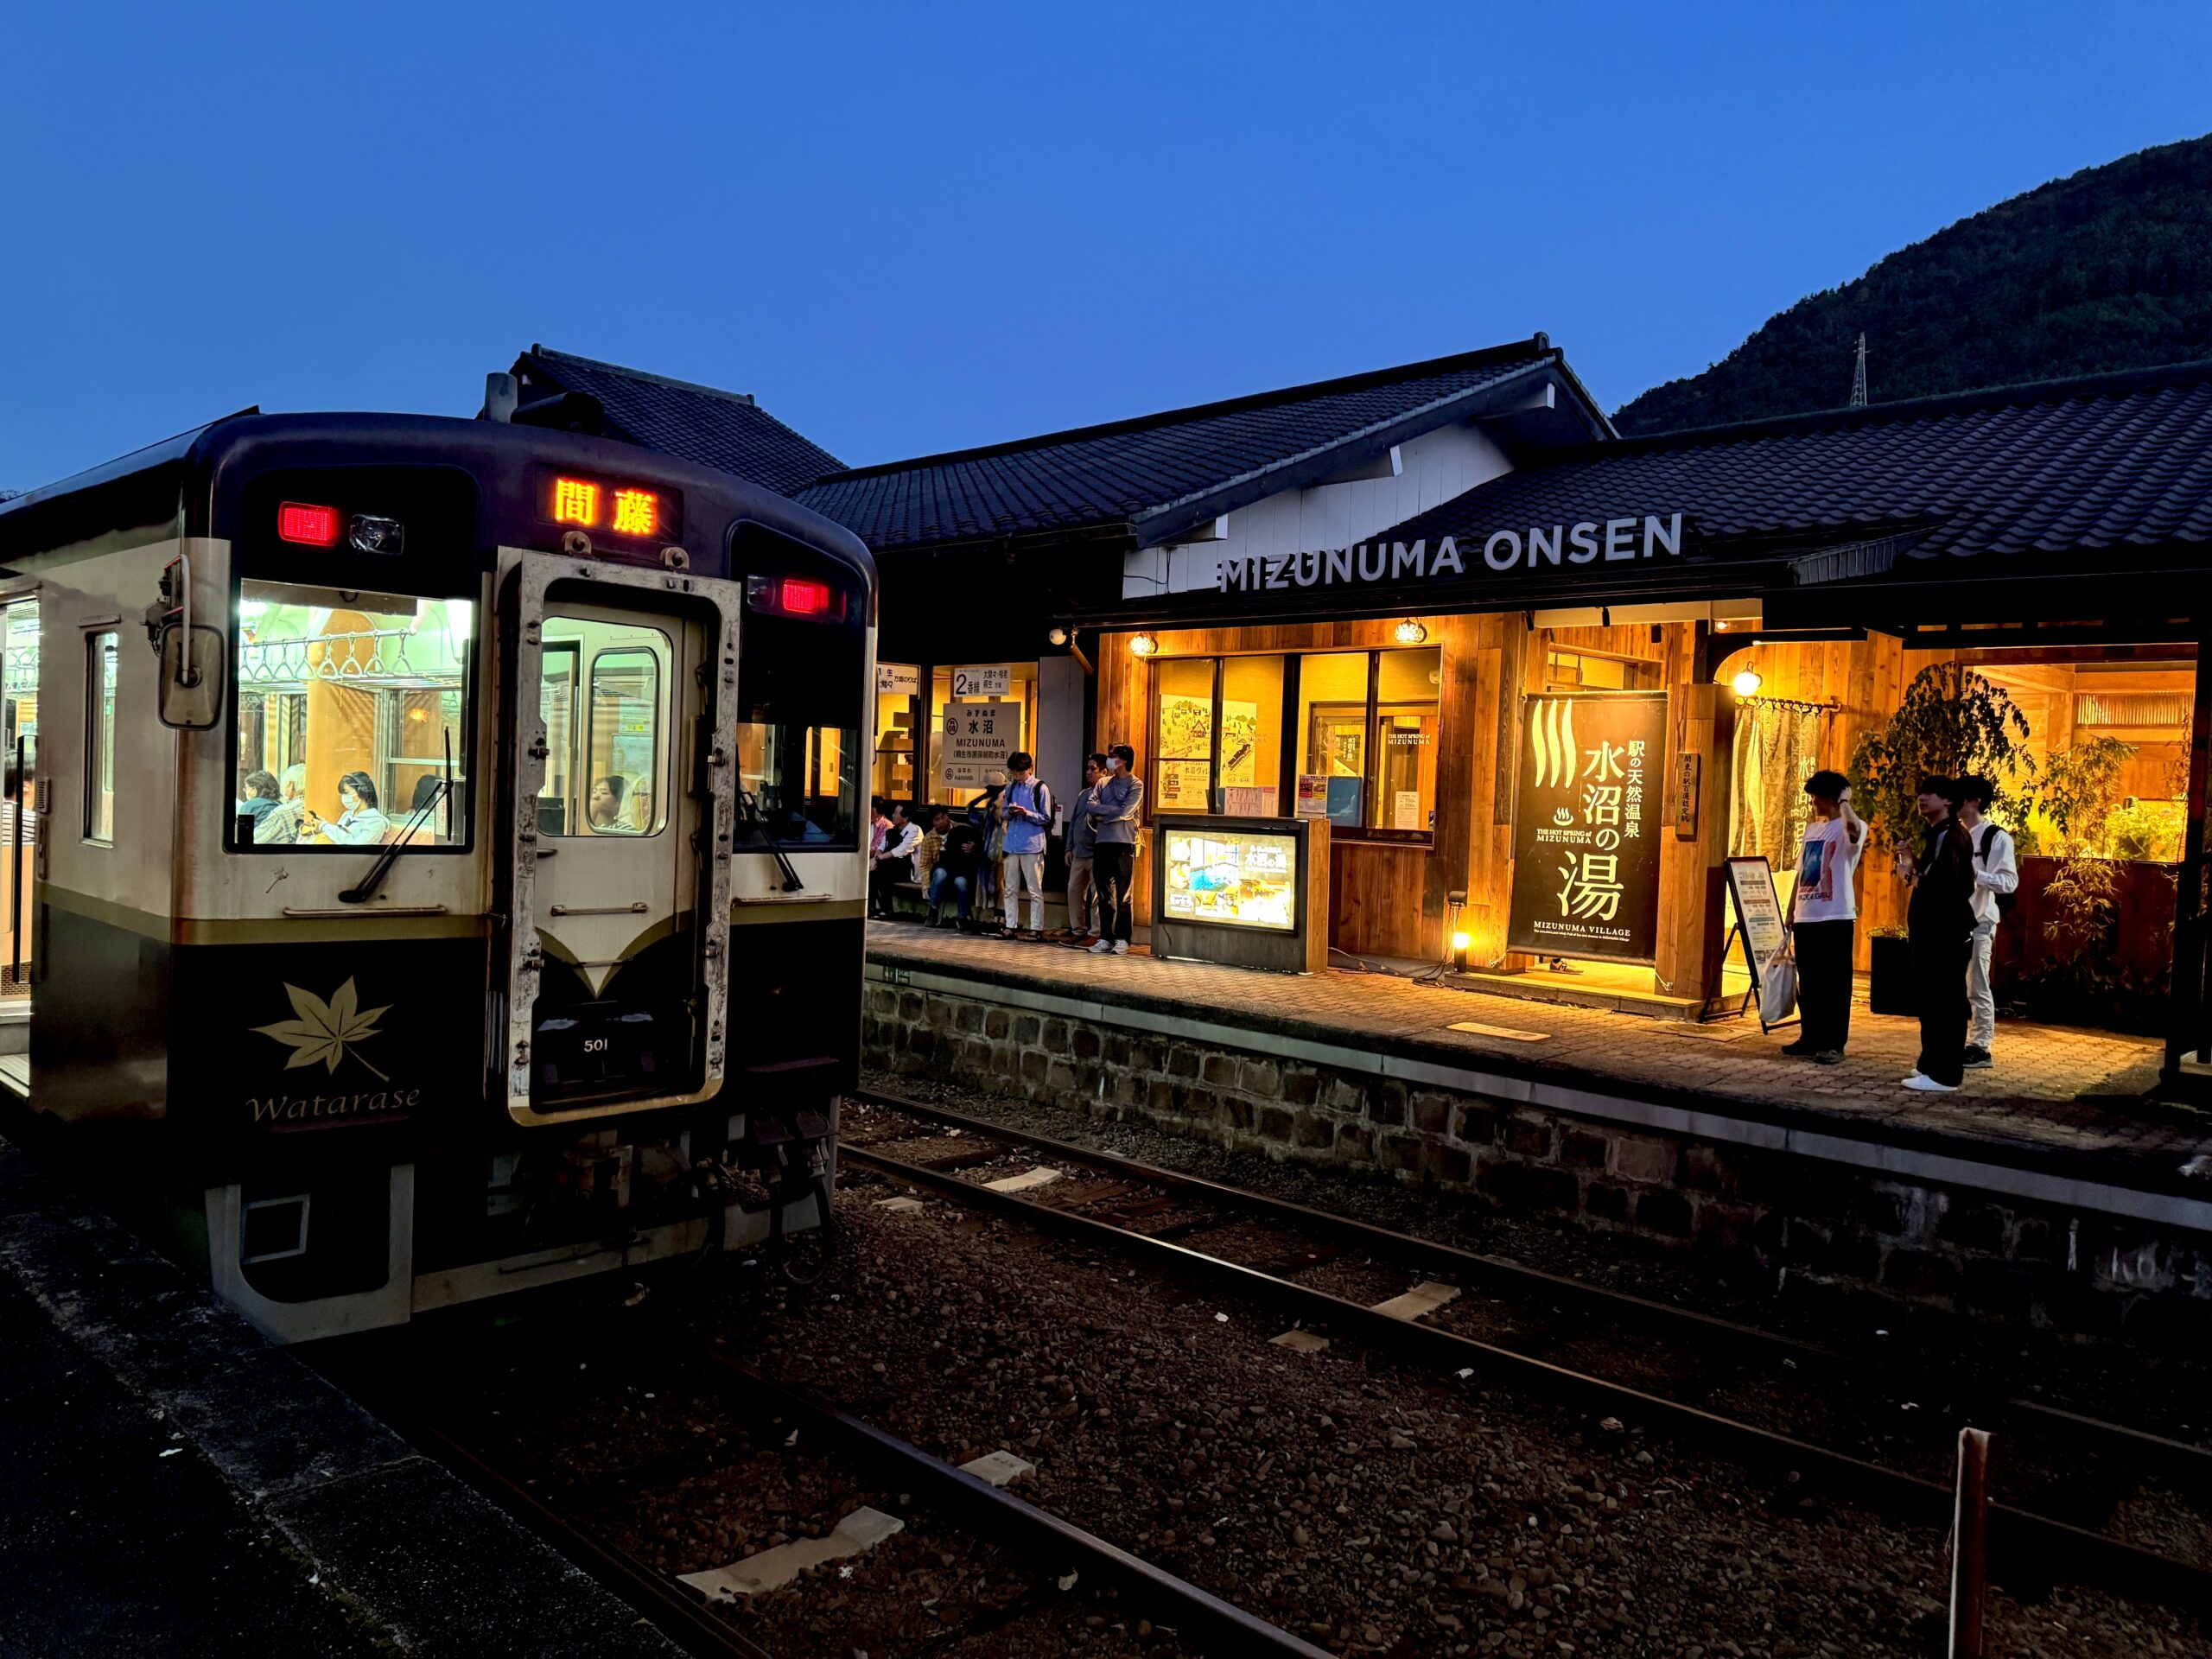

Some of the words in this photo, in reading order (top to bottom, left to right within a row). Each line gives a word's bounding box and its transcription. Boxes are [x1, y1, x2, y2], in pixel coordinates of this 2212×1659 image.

[555, 477, 654, 533] 間藤
[1219, 536, 1464, 594] MIZUNUMA
[1484, 512, 1682, 571] ONSEN
[956, 673, 967, 695] 2
[968, 719, 994, 734] 水沼
[956, 738, 1006, 747] MIZUNUMA
[1624, 740, 1646, 838] 駅の天然温泉
[1536, 834, 1592, 844] MIZUNUMA
[1556, 741, 1625, 922] 水沼の湯
[1534, 920, 1586, 932] MIZUNUMA
[1588, 925, 1631, 937] VILLAGE
[583, 1038, 608, 1052] 501
[245, 1085, 422, 1123] Watarase
